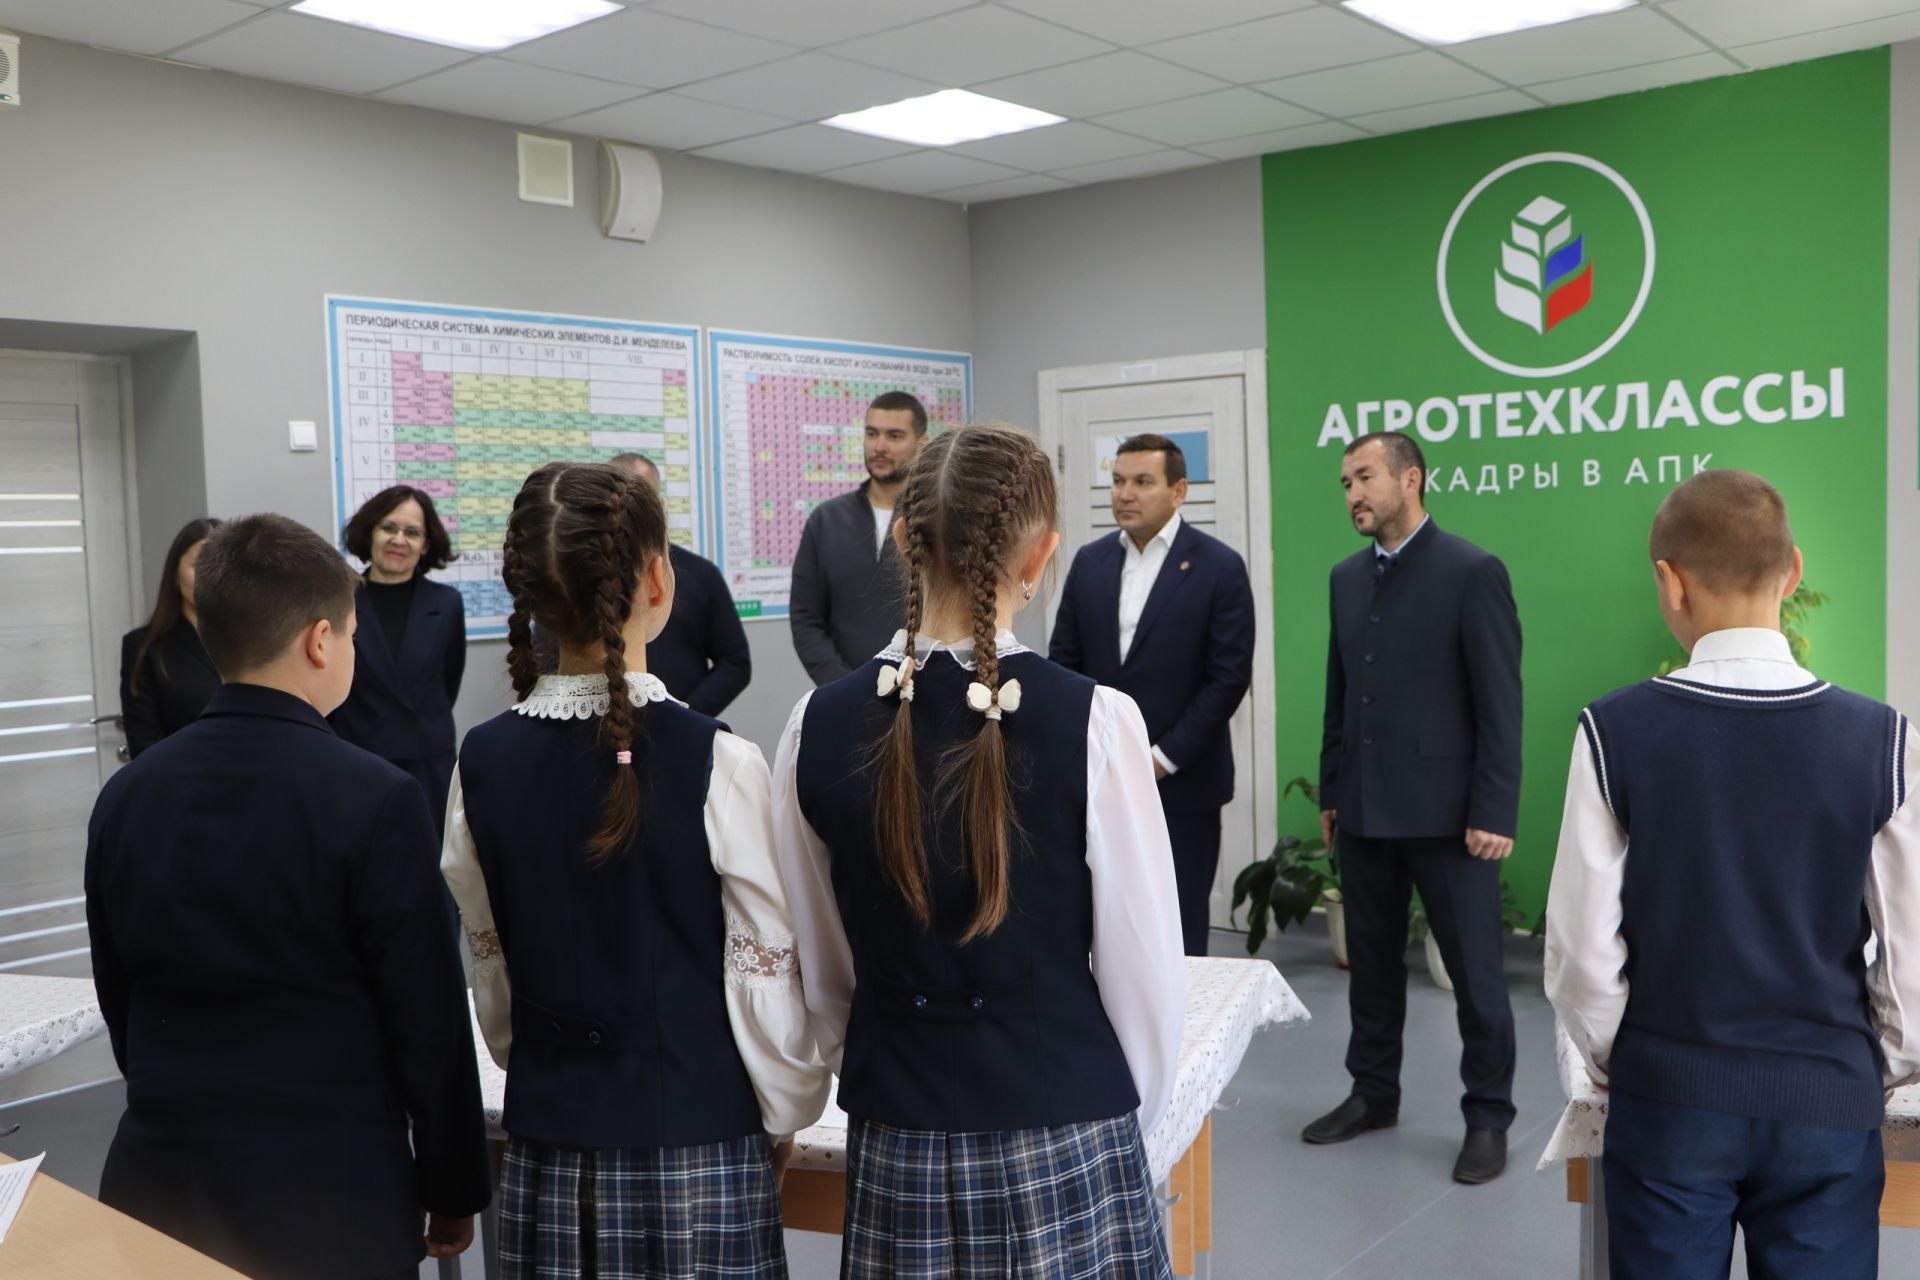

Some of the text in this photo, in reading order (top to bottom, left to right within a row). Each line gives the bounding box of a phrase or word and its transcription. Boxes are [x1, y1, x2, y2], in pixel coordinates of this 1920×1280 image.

[345, 314, 440, 331] ПЕРИОДИЧЕСКАЯ
[441, 321, 491, 335] СИСТЕМА
[492, 326, 556, 340] ХИМИЧЕСКИХ
[557, 330, 611, 345] ЭЛЕМЕНТОВ
[631, 337, 687, 351] МЕНДЕЛЕЕВА
[722, 348, 793, 364] РАСТВОРИМОСТЬ
[823, 356, 853, 369] КИСЛОТ
[861, 359, 906, 372] ОСНОВАНИЙ
[1316, 366, 1846, 448] АГРОТЕХКЛАССЫ
[1424, 452, 1713, 496] КАДРЫ В АПК
